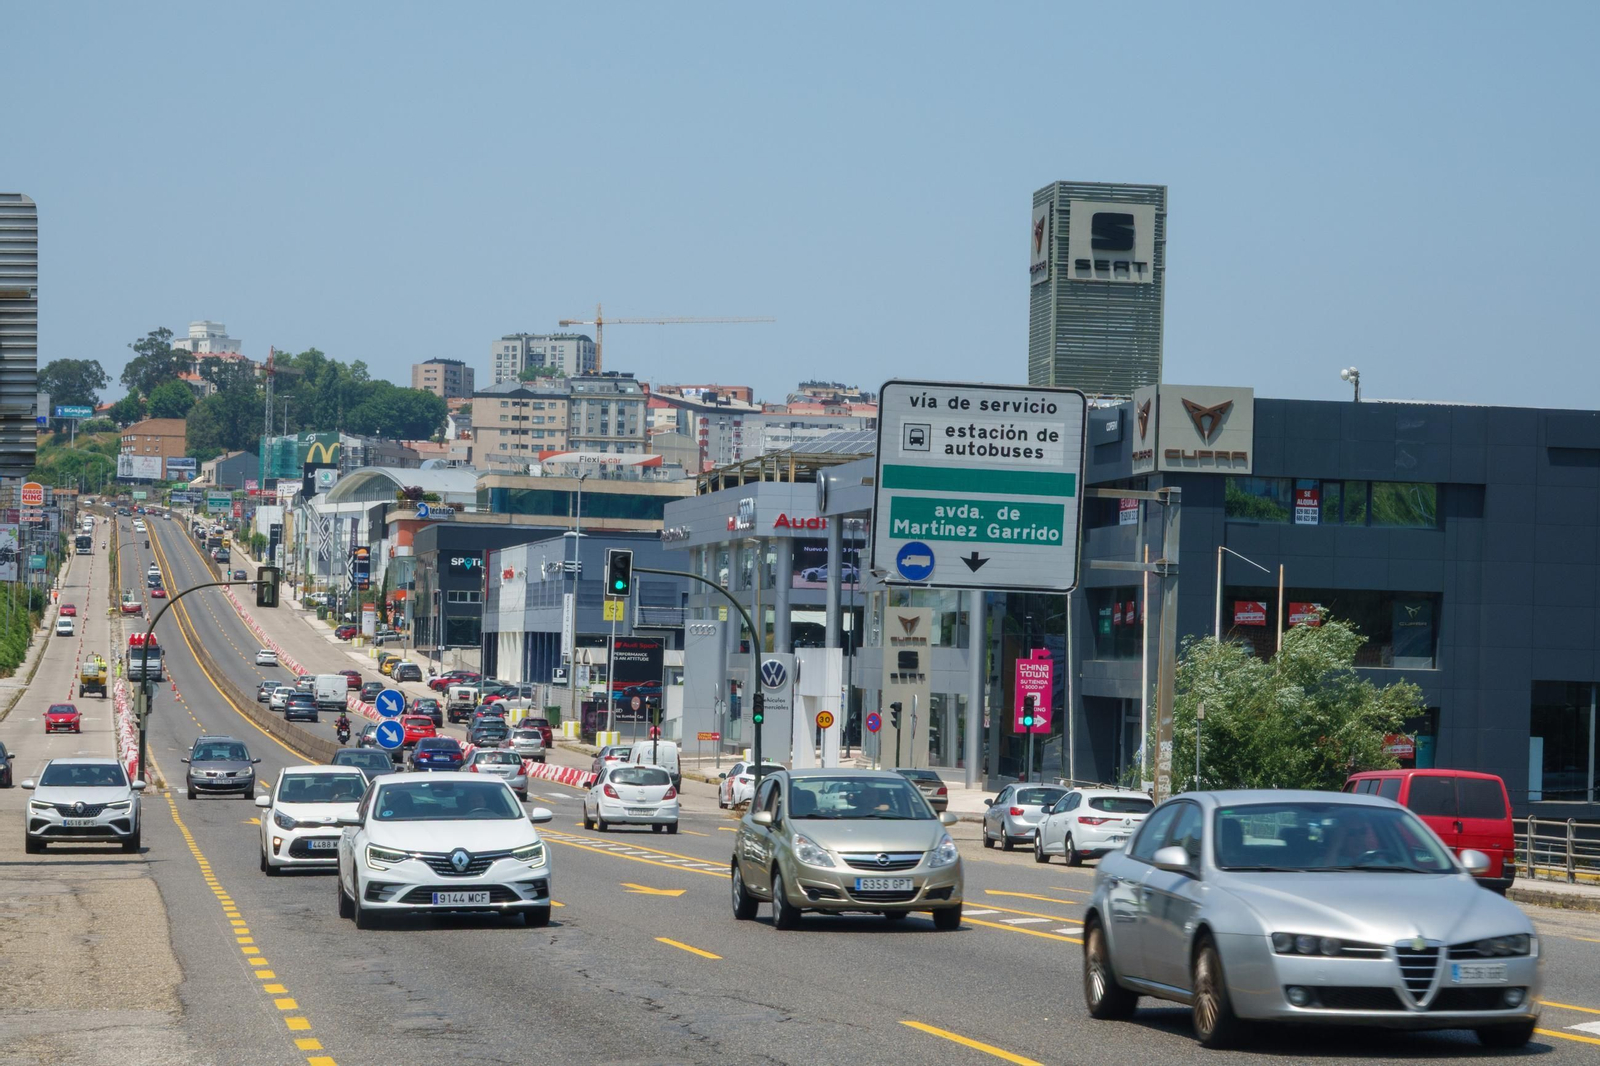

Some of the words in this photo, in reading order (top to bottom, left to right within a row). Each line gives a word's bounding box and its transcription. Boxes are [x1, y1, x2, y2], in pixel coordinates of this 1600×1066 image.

[1075, 259, 1148, 272] SEAT
[909, 392, 937, 408] vía
[948, 396, 970, 410] de
[979, 397, 1058, 414] servicio
[945, 423, 1028, 441] estación
[1037, 428, 1059, 443] de
[945, 441, 1044, 459] autobuses
[1165, 449, 1248, 461] CUPRA
[935, 504, 984, 519] avda.
[997, 507, 1020, 521] de
[774, 513, 827, 530] Audi
[893, 518, 978, 538] Martínez
[987, 523, 1059, 541] Garrido
[1020, 671, 1049, 679] TOWN
[863, 880, 889, 889] 6356
[893, 880, 911, 889] GPT
[440, 893, 465, 903] 9144
[468, 893, 487, 903] MCF
